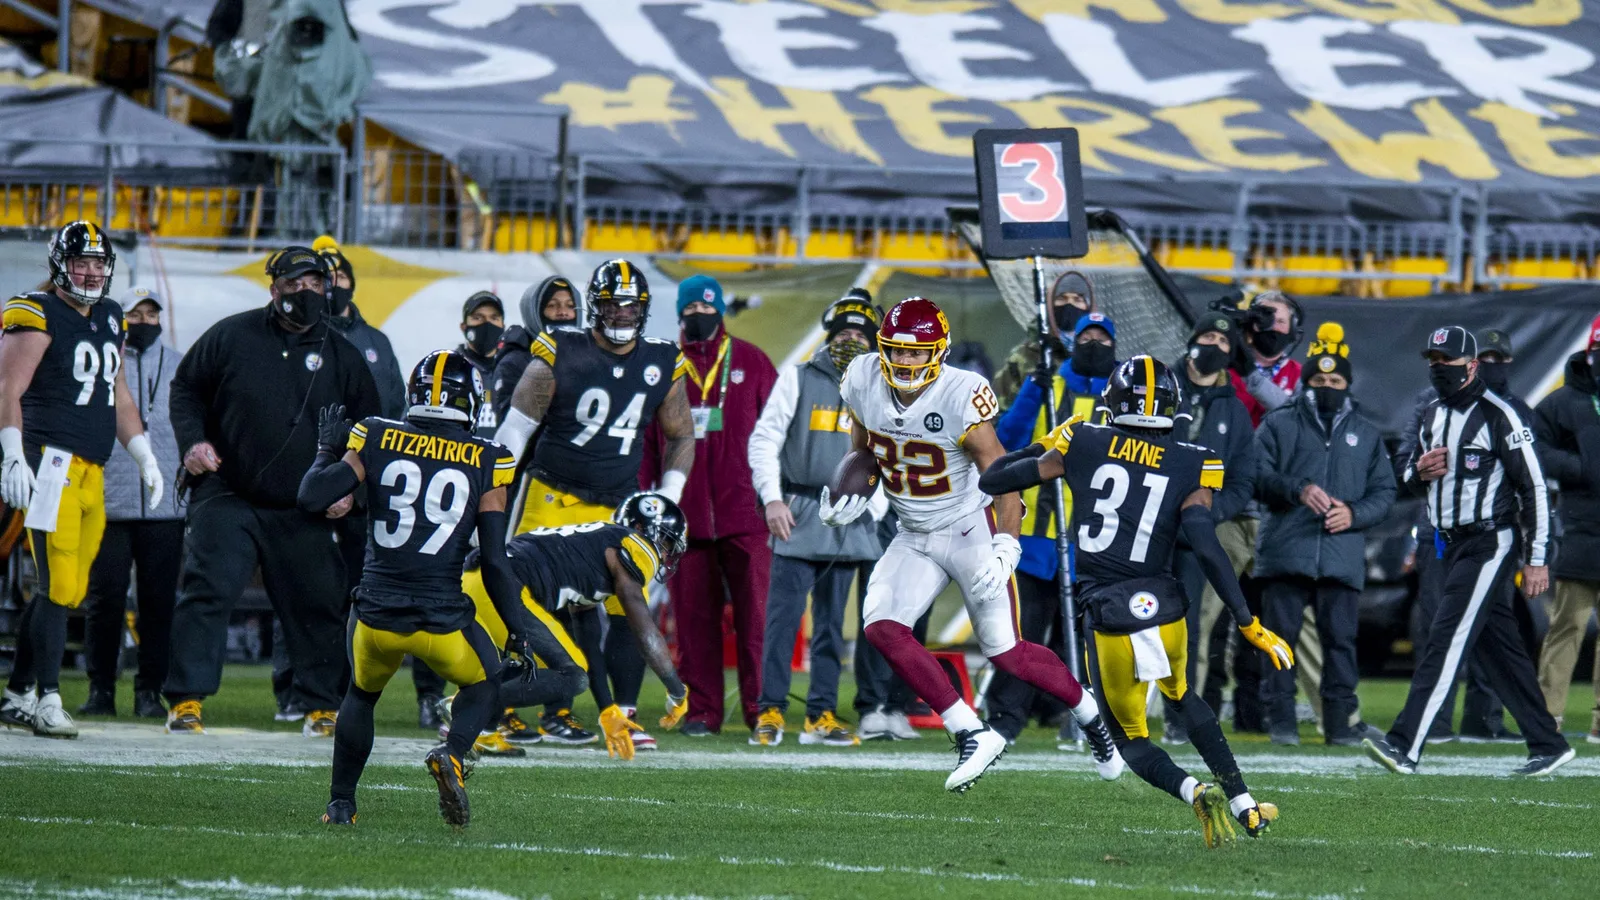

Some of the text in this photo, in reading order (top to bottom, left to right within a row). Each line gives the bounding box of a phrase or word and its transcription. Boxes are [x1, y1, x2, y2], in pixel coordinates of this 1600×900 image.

[998, 142, 1064, 223] 3
[73, 341, 121, 406] 99
[424, 389, 449, 407] 39
[971, 385, 998, 418] 82
[1136, 398, 1159, 417] 31
[571, 388, 647, 456] 94
[879, 427, 923, 439] WASHINGTON
[924, 415, 942, 429] 49
[380, 428, 484, 468] FITZPATRICK
[867, 429, 952, 498] 82
[1108, 435, 1165, 469] LAYNE
[373, 459, 470, 556] 39
[1077, 463, 1170, 564] 31
